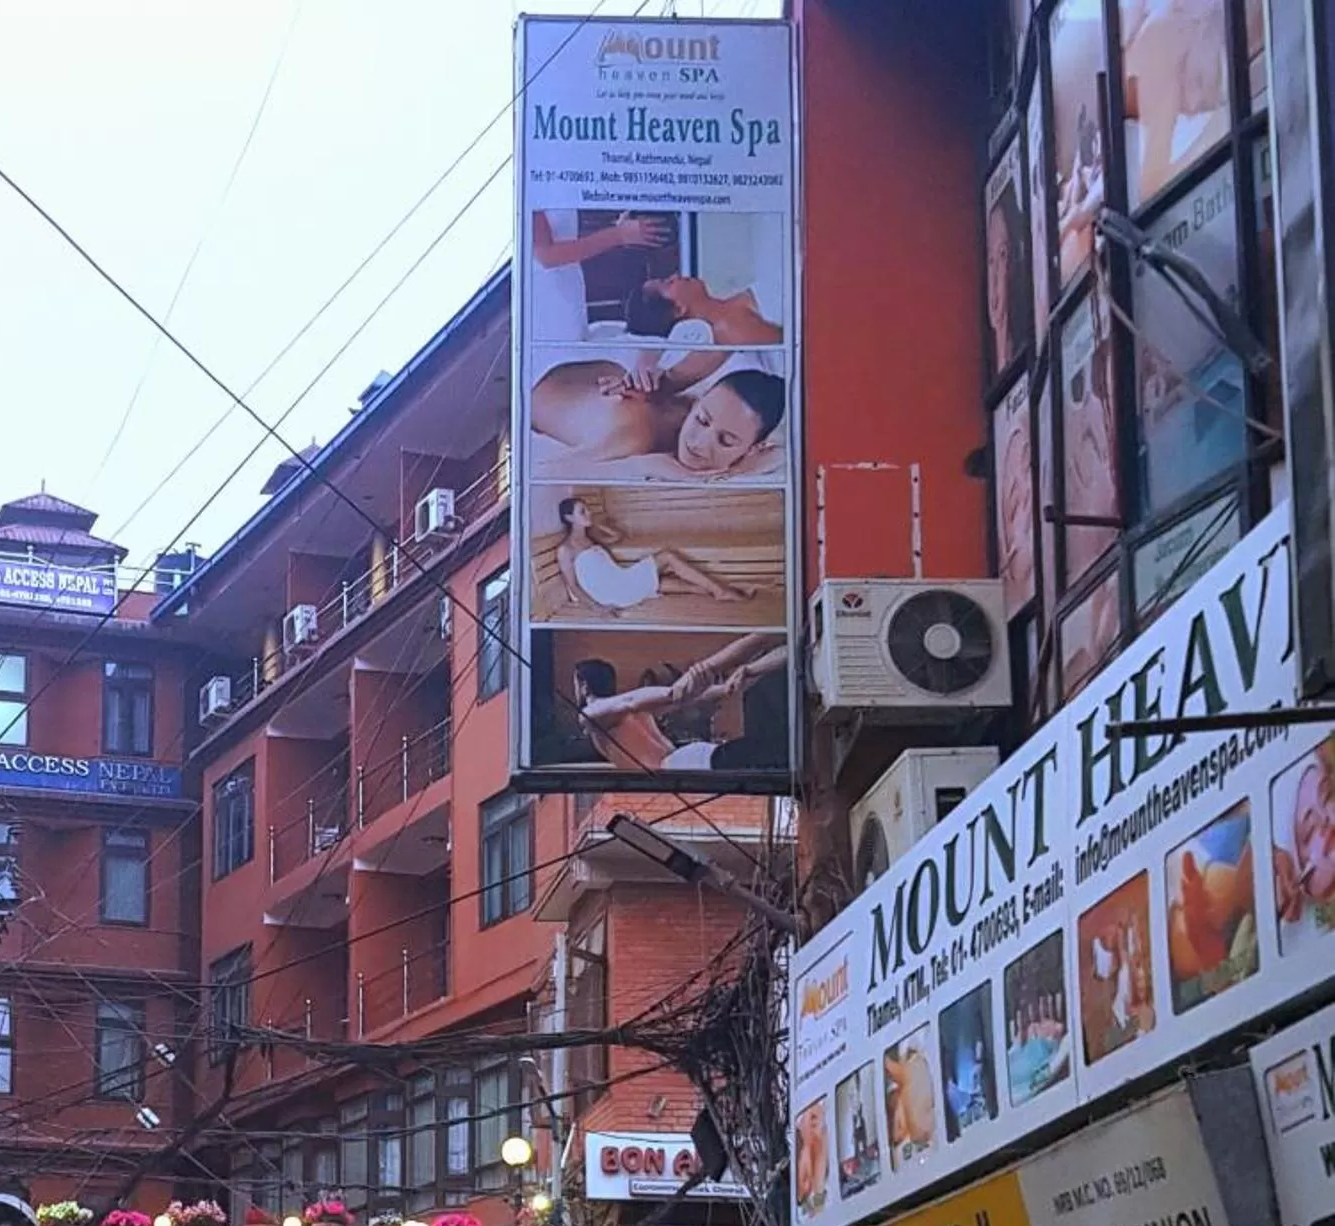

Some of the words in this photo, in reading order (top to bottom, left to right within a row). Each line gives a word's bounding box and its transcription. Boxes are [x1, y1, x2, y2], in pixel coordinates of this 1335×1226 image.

[679, 68, 719, 83] SPA
[533, 105, 617, 141] Mount
[627, 107, 721, 143] Heaven
[731, 108, 781, 157] Spa
[4, 568, 55, 589] ACCESS
[58, 572, 99, 594] NEPAL
[98, 763, 173, 783] NEPAL
[867, 742, 1058, 993] MOUNT
[1076, 533, 1293, 829] HEAV
[601, 1146, 665, 1176] BON
